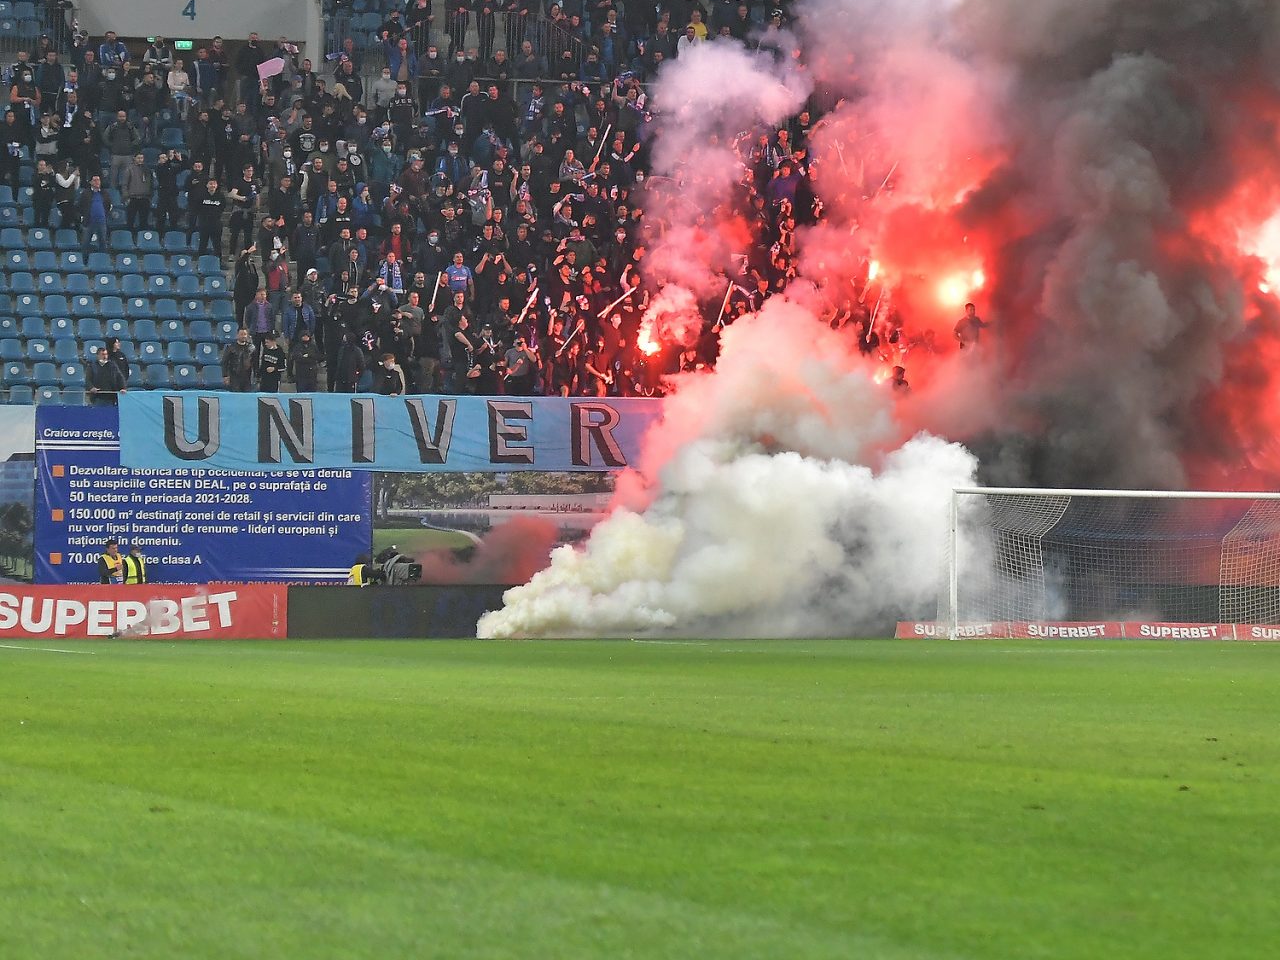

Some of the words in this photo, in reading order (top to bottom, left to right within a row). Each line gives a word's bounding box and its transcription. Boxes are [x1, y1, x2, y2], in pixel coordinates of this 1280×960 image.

[182, 0, 197, 21] 4
[44, 428, 80, 438] Craiova
[69, 465, 128, 476] Dezvoltare
[286, 470, 300, 478] se
[317, 469, 352, 478] derula
[69, 479, 91, 489] sub
[93, 479, 146, 491] auspiciile
[149, 479, 191, 489] GREEN
[194, 480, 230, 491] DEAL,
[233, 482, 246, 492] pe
[249, 482, 257, 490] o
[259, 481, 310, 493] suprafață
[313, 481, 327, 491] de
[69, 491, 84, 502] 50
[87, 492, 129, 502] hectare
[131, 493, 142, 503] în
[144, 493, 193, 505] perioada
[195, 493, 253, 504] 2021-2028.
[69, 508, 115, 520] 150.000
[135, 510, 182, 522] destinați
[185, 510, 214, 521] zonei
[217, 511, 230, 521] de
[233, 511, 261, 521] retail
[263, 511, 273, 523] și
[276, 511, 315, 522] servicii
[317, 512, 334, 522] din
[337, 513, 361, 522] care
[68, 524, 82, 532] nu
[85, 524, 104, 533] vor
[106, 523, 129, 534] lipsi
[132, 523, 178, 533] branduri
[181, 524, 195, 533] de
[198, 525, 239, 534] renume
[248, 525, 275, 534] lideri
[277, 525, 326, 537] europeni
[328, 525, 338, 538] și
[118, 536, 128, 545] în
[131, 536, 182, 546] domeniu.
[68, 552, 101, 564] 70.00
[161, 555, 191, 565] clasa
[192, 554, 202, 565] A
[0, 591, 237, 637] SUPERBET
[914, 623, 993, 637] SUPRBET
[1027, 624, 1106, 638] SUPERBET
[1140, 624, 1218, 639] SUPERBET
